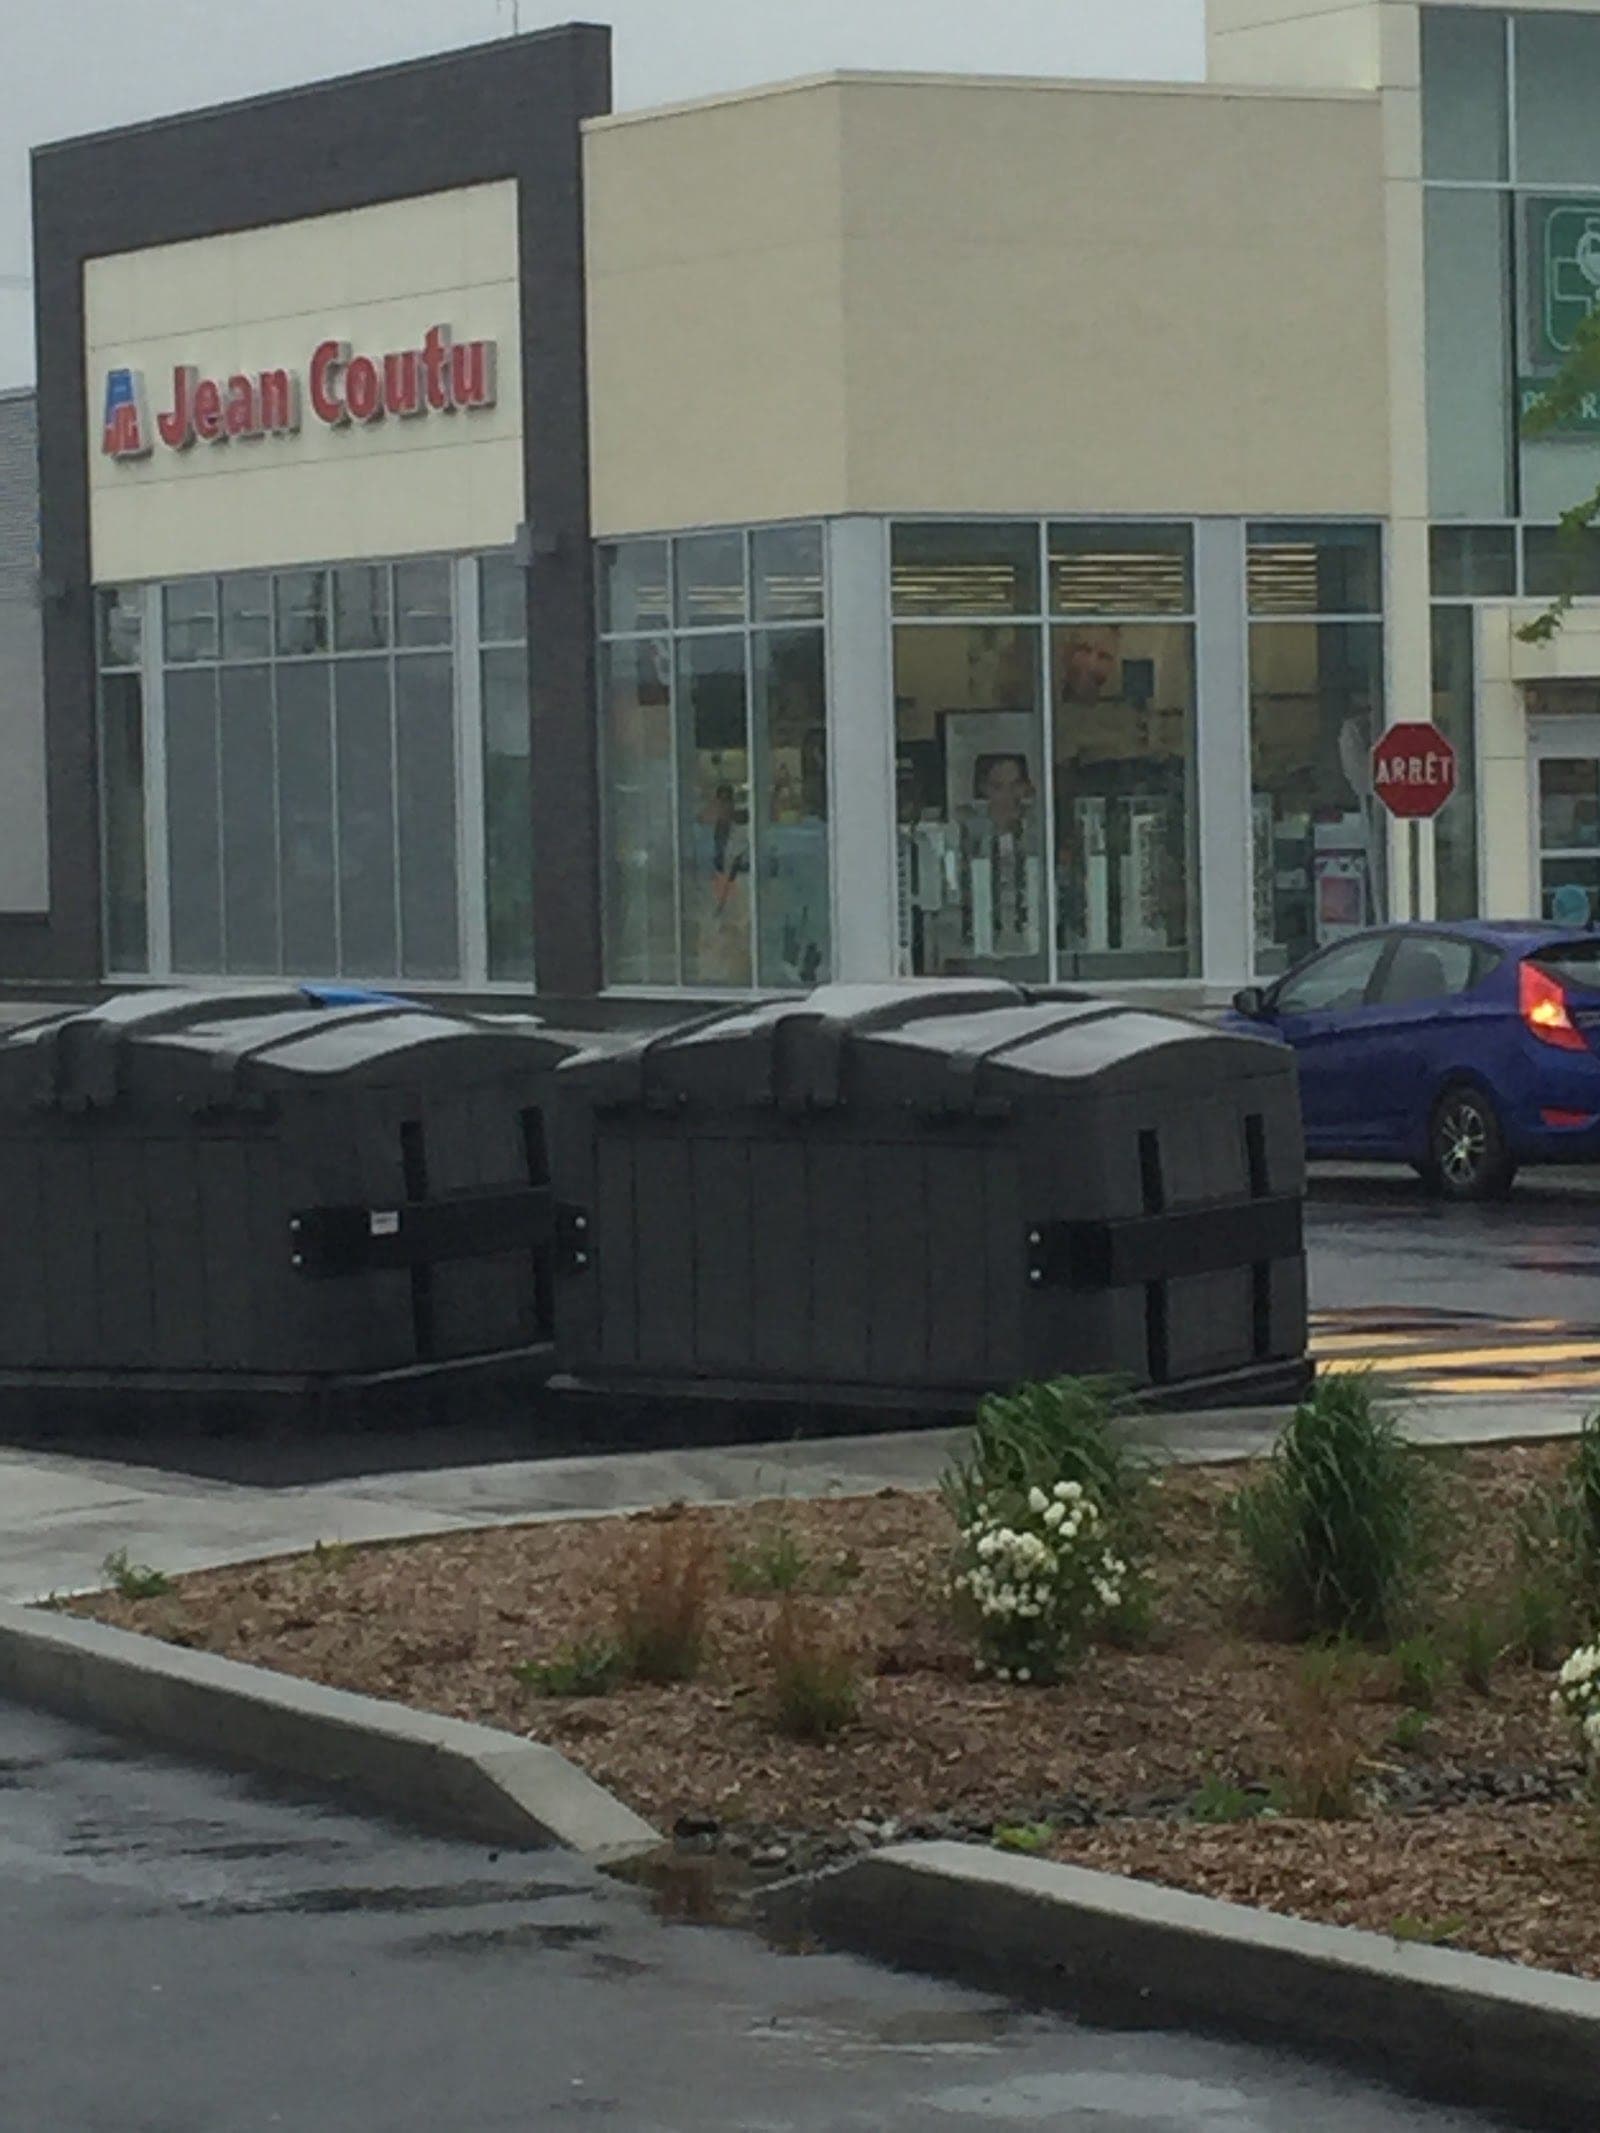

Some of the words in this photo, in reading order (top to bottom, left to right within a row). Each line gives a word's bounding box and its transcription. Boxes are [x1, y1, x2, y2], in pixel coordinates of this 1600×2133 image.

[156, 364, 293, 449] Jean
[309, 323, 488, 425] Coutu
[1376, 751, 1451, 785] ARRÊT
